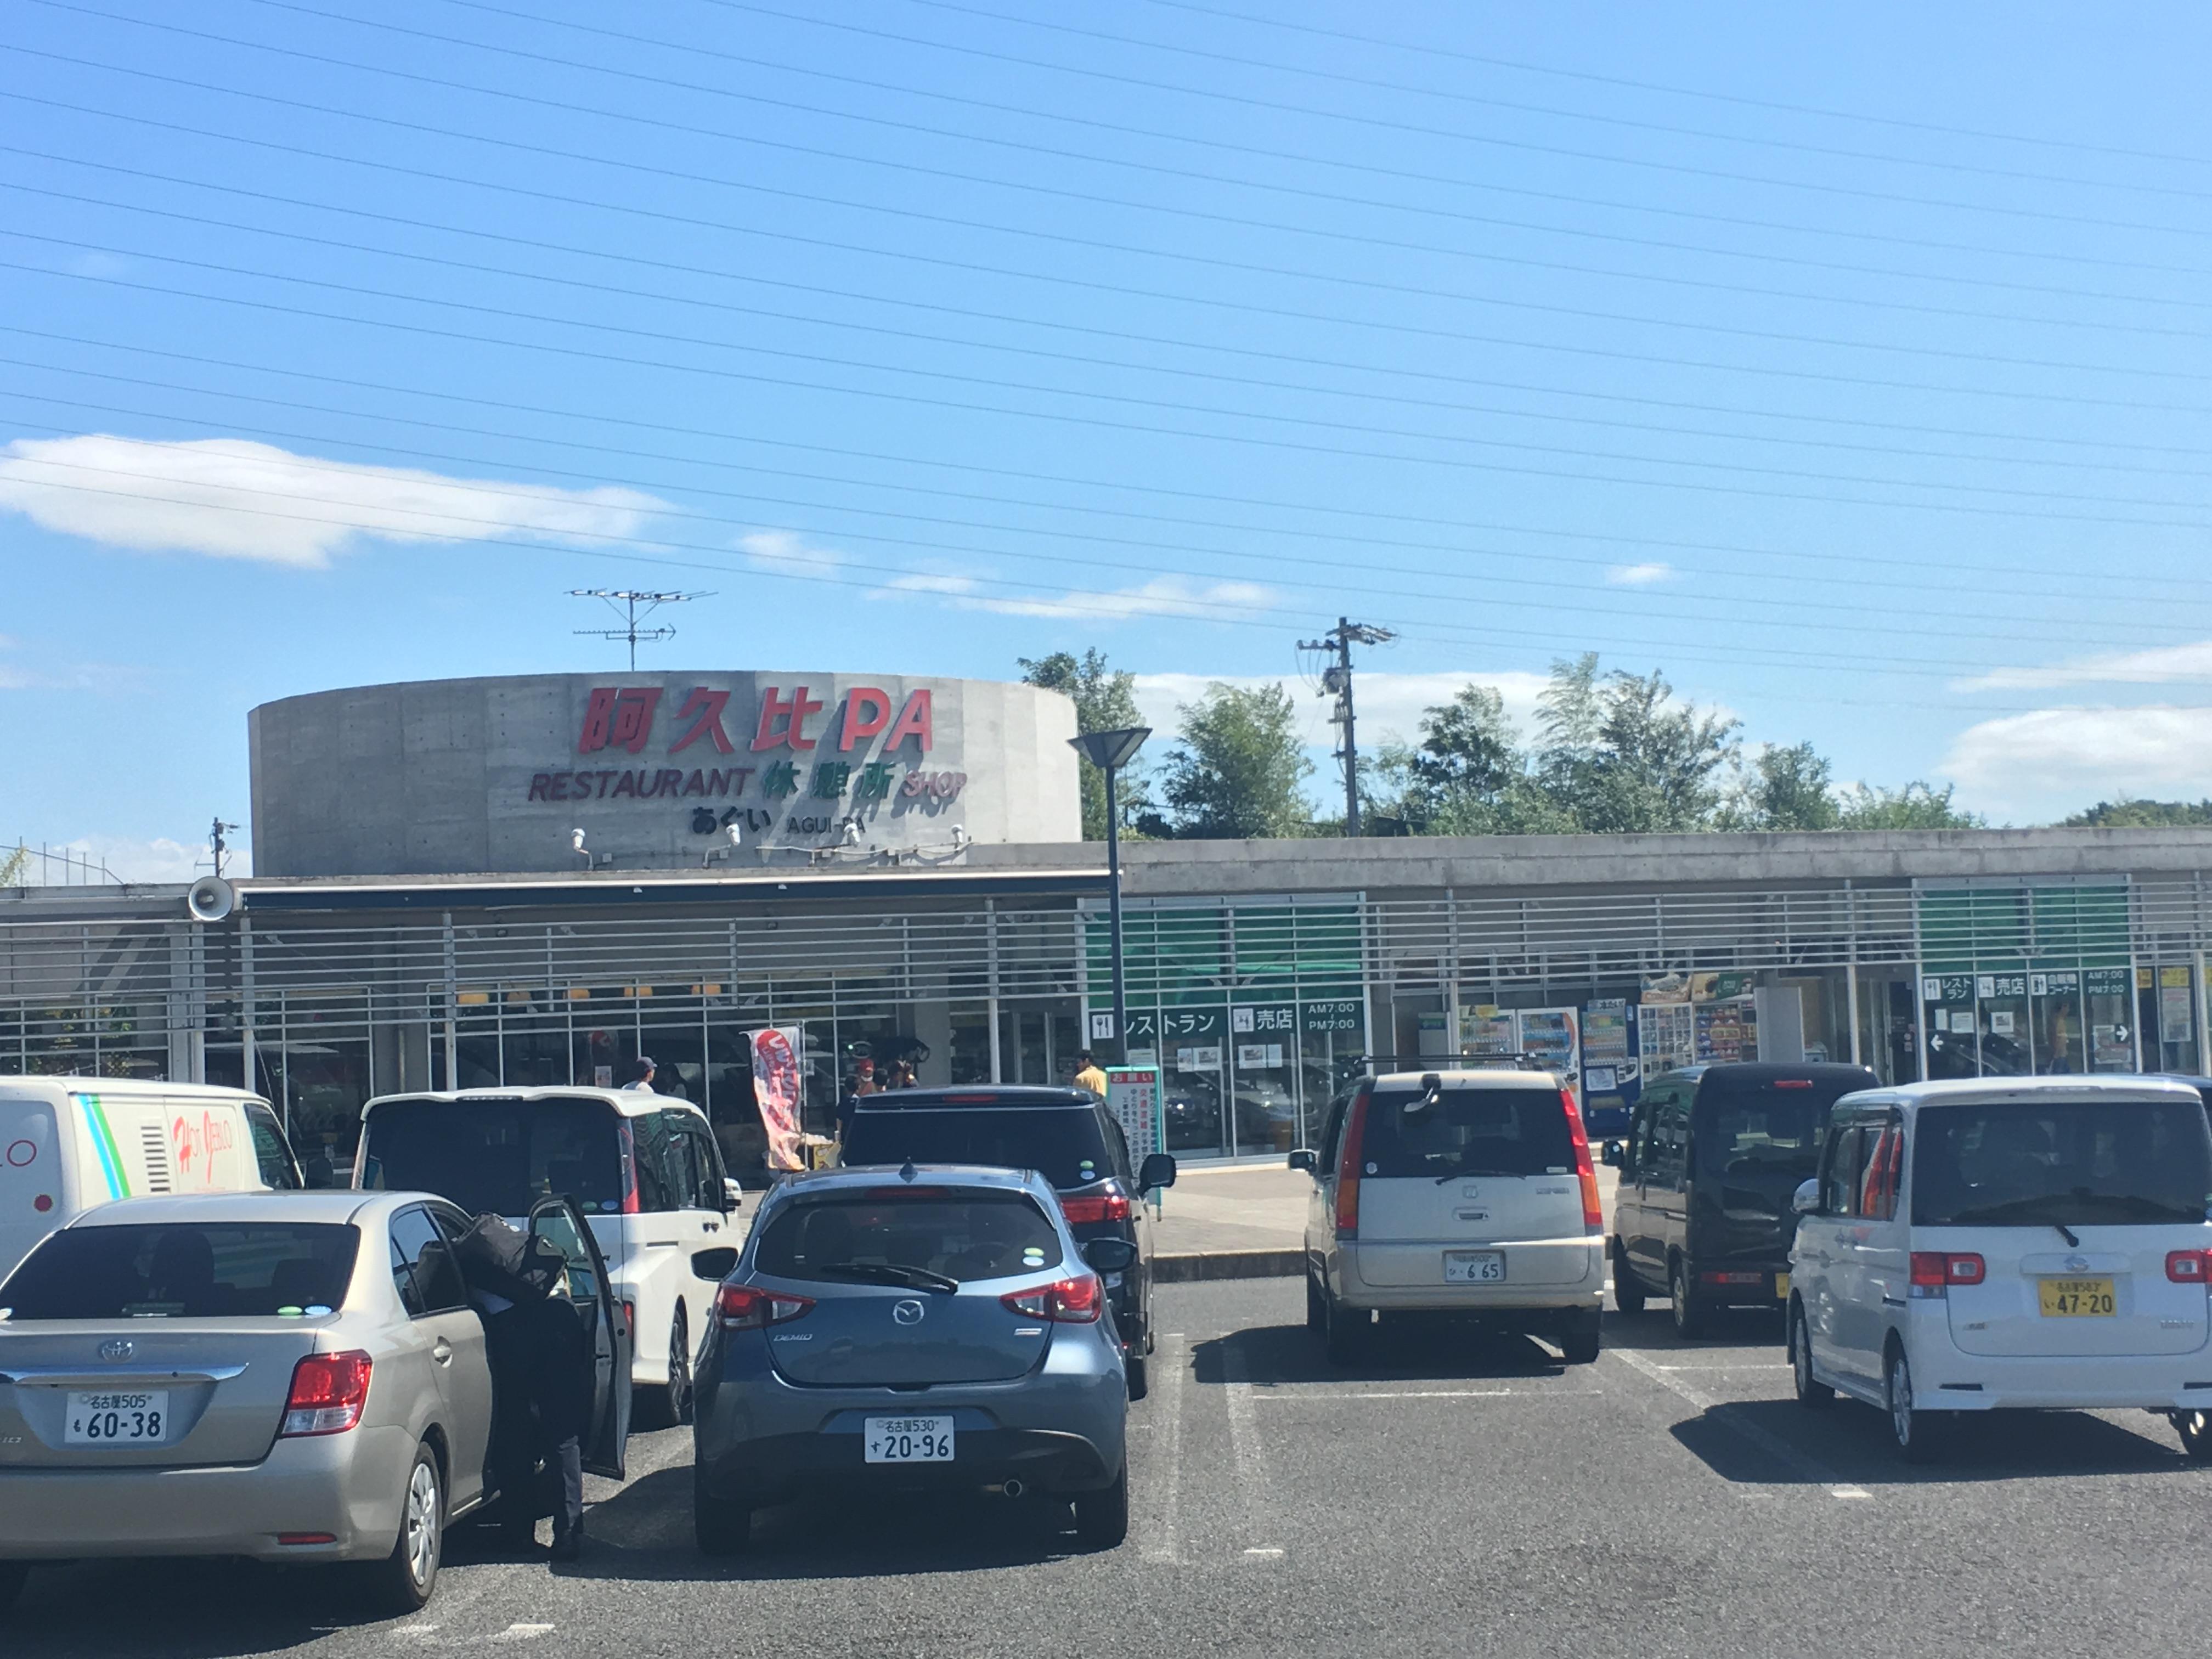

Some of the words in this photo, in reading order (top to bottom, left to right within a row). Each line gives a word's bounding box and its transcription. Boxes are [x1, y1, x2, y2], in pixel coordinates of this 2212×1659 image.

[578, 686, 933, 754] 阿久比PA
[528, 769, 755, 802] RESTAURANT
[763, 760, 896, 799] 休憩所
[904, 769, 967, 797] SHOP
[692, 806, 771, 834] あぐい
[1942, 978, 1972, 989] レスト
[1996, 978, 2024, 995] 売店
[1948, 989, 1967, 1000] ラン
[1257, 1008, 1293, 1030] 売店
[1308, 1003, 1355, 1014] AM7:00
[1308, 1019, 1355, 1030] PM7:00
[2057, 1294, 2112, 1314] 47-20
[87, 1412, 161, 1438] 60-38
[884, 1435, 949, 1458] 20-96
